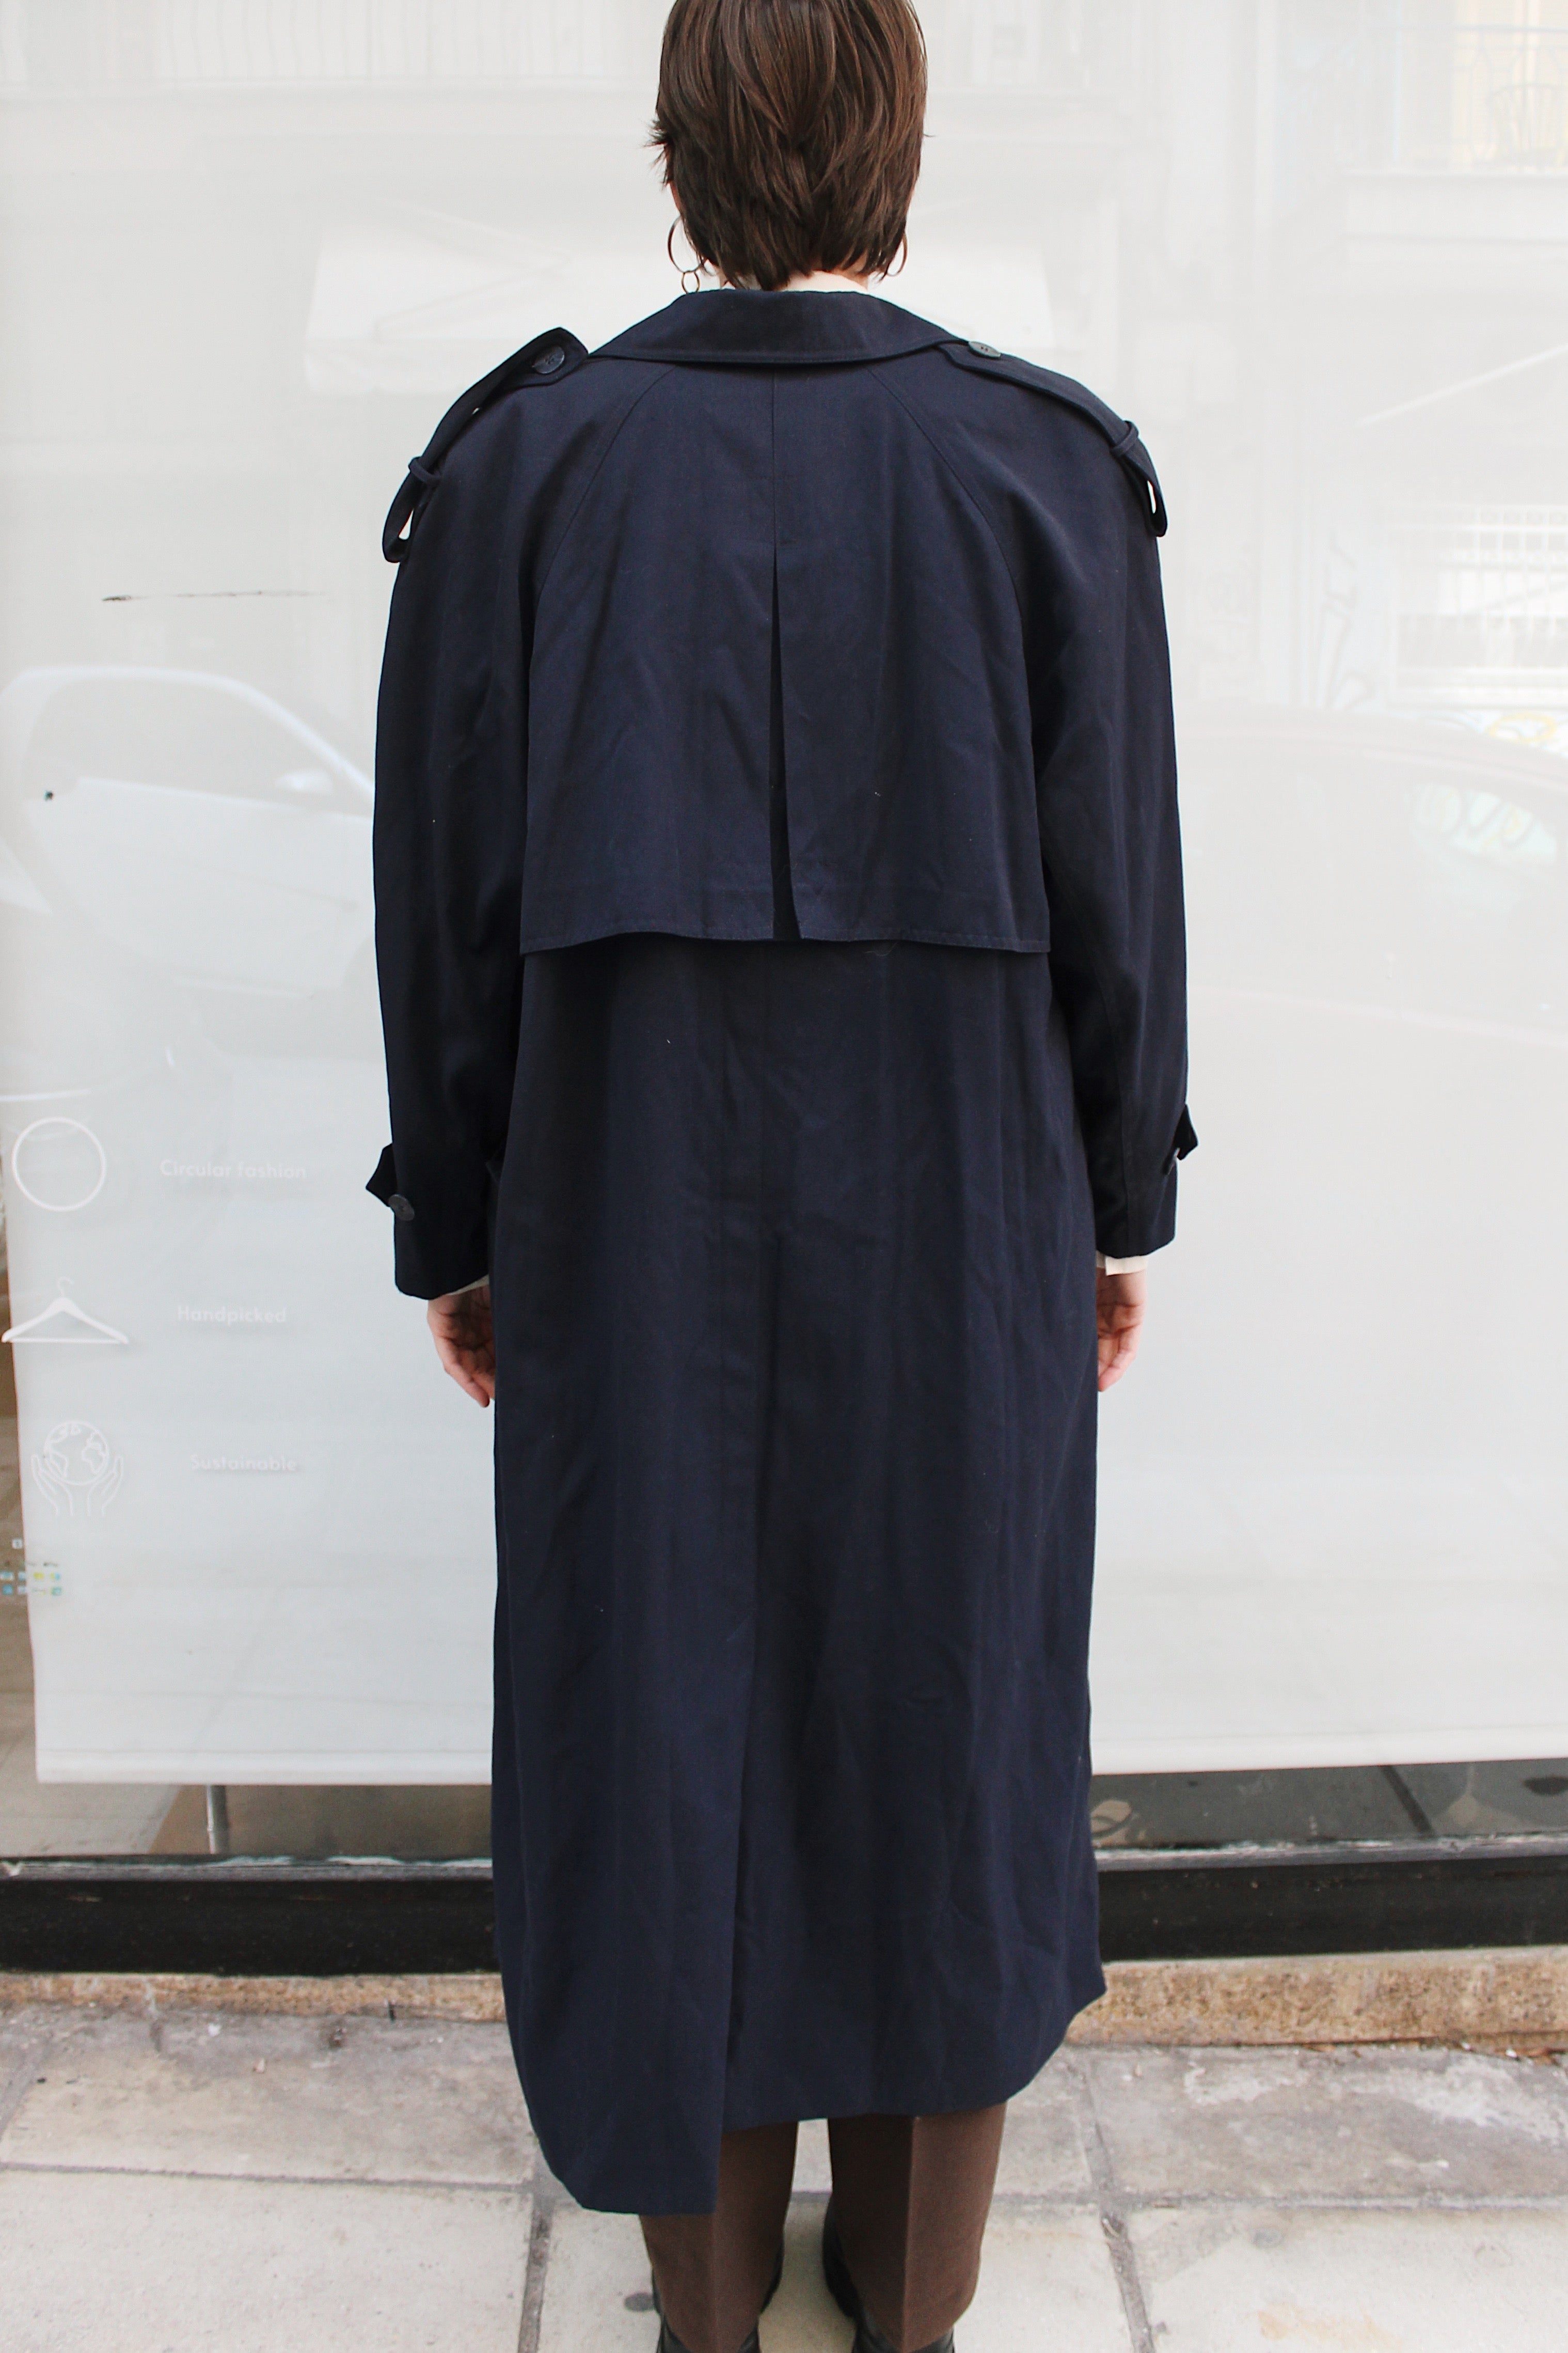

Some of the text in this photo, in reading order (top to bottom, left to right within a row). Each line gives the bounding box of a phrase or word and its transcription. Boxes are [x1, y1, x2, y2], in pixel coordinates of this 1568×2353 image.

[159, 1159, 307, 1179] Circular fashion
[178, 1305, 287, 1326] Handpicked
[190, 1453, 298, 1471] Sustainable
